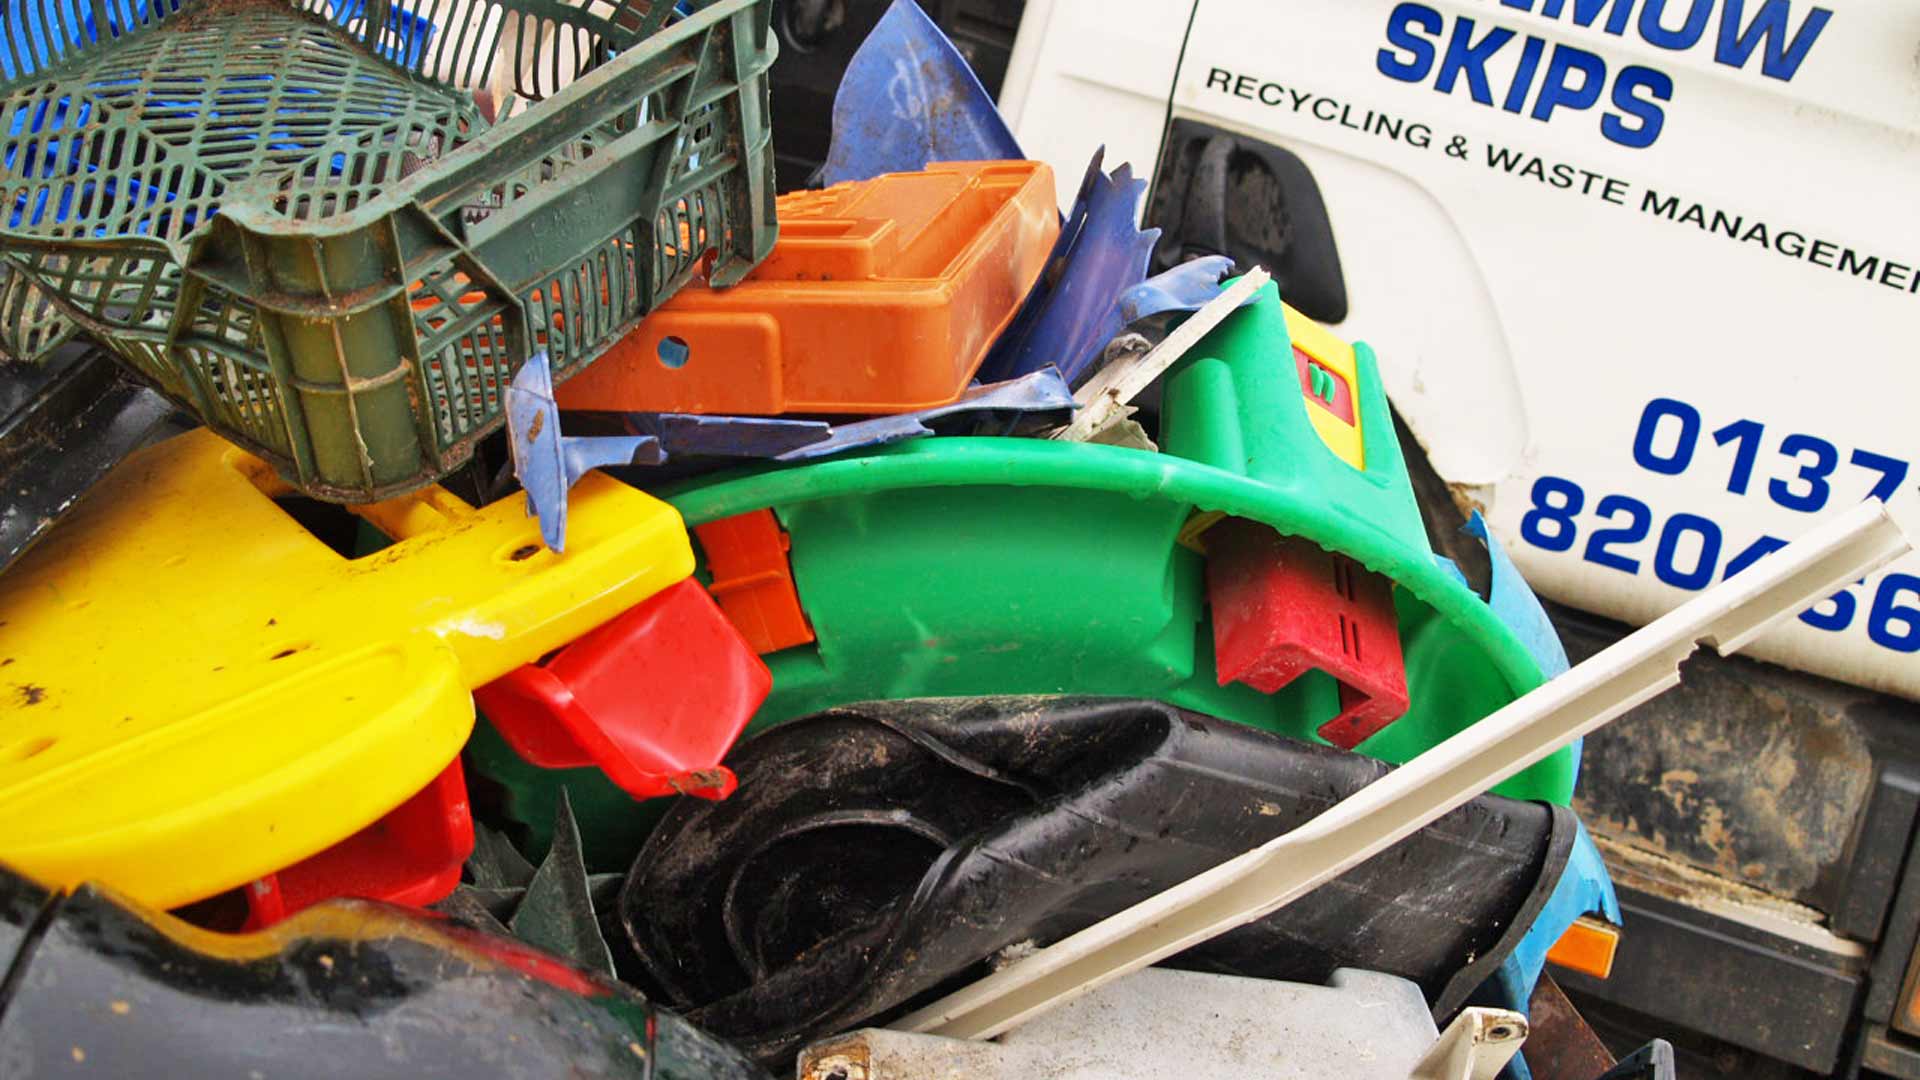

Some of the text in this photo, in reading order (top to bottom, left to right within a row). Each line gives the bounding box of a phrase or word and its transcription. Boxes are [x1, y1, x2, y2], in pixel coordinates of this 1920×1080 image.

[1375, 2, 1674, 149] SKIPS
[1499, 0, 1834, 82] OW
[1206, 67, 1431, 149] RECYCLING
[1445, 136, 1468, 160] &
[1487, 144, 1629, 205] WASTE
